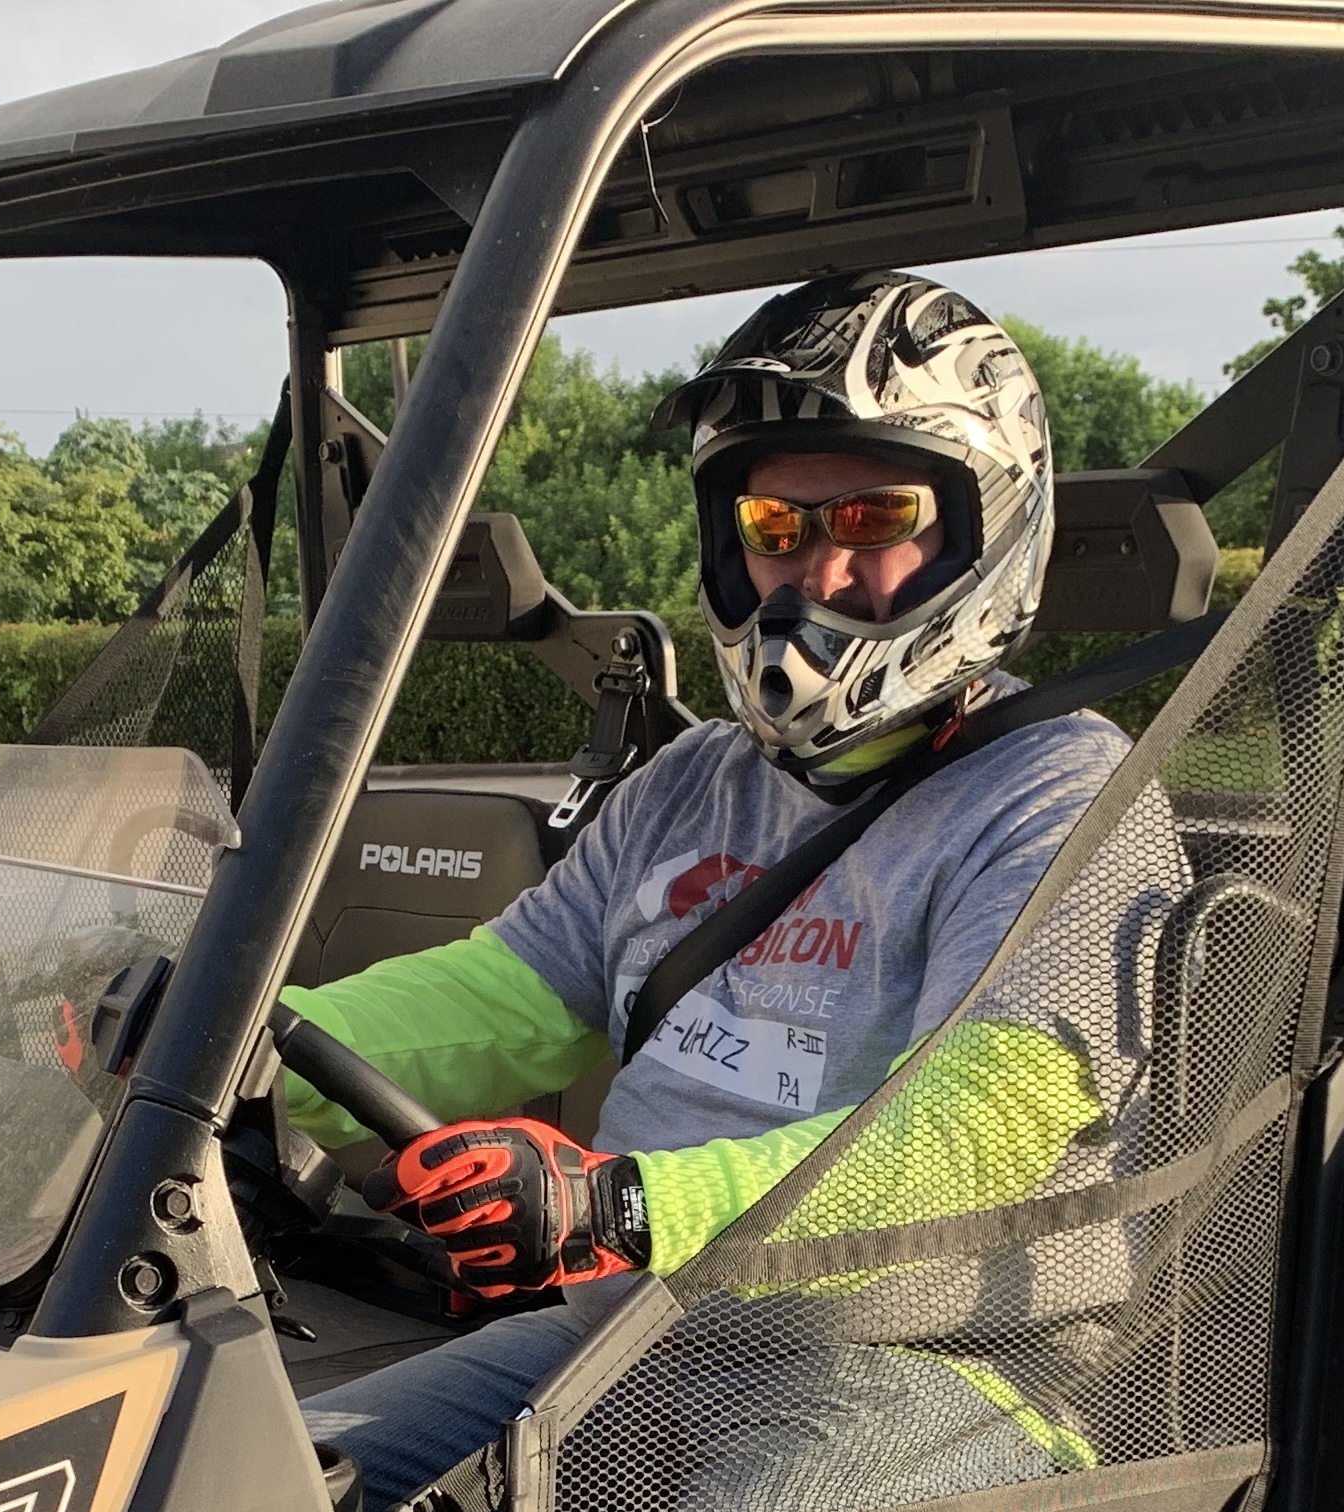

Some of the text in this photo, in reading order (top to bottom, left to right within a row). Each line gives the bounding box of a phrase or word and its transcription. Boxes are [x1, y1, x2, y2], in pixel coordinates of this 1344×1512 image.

[359, 843, 483, 879] POLARIS
[722, 906, 863, 970] BICON
[777, 1072, 800, 1106] PA
